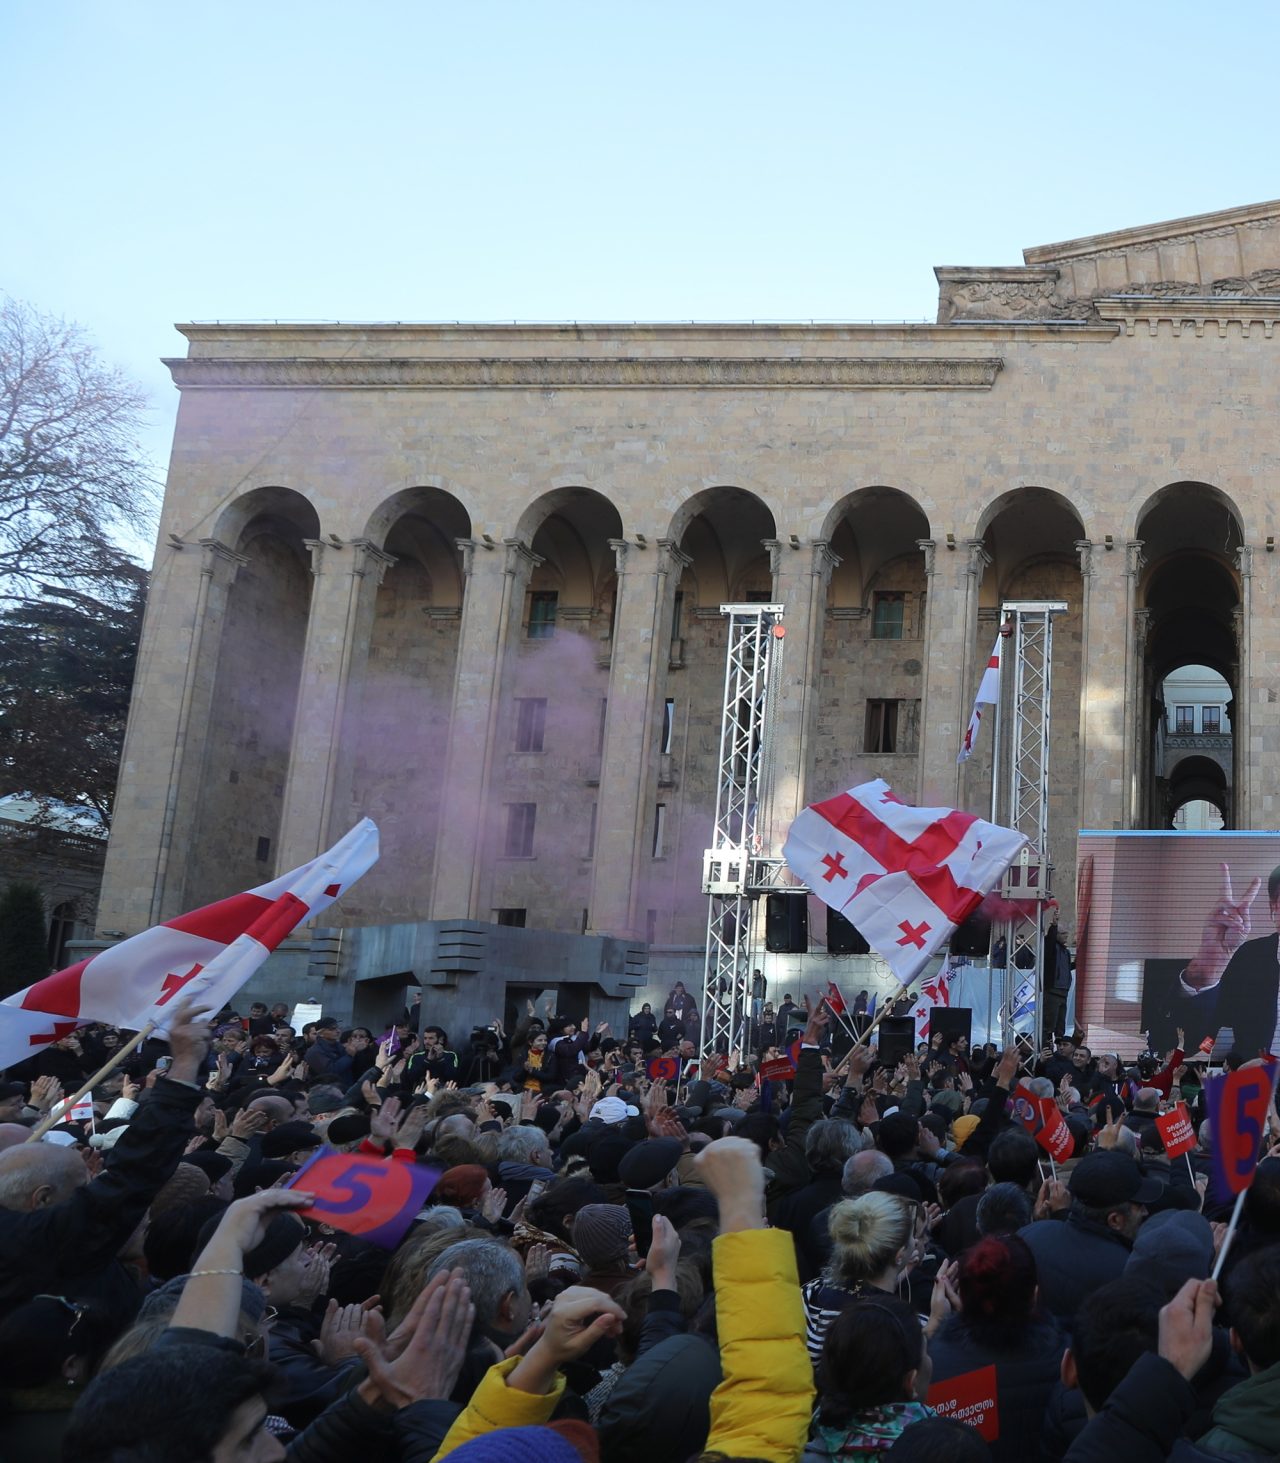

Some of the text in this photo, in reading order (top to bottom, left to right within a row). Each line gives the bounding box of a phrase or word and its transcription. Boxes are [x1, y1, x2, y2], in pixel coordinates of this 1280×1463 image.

[657, 1060, 670, 1074] 5
[1236, 1083, 1260, 1176] 5
[312, 1164, 390, 1215] 5
